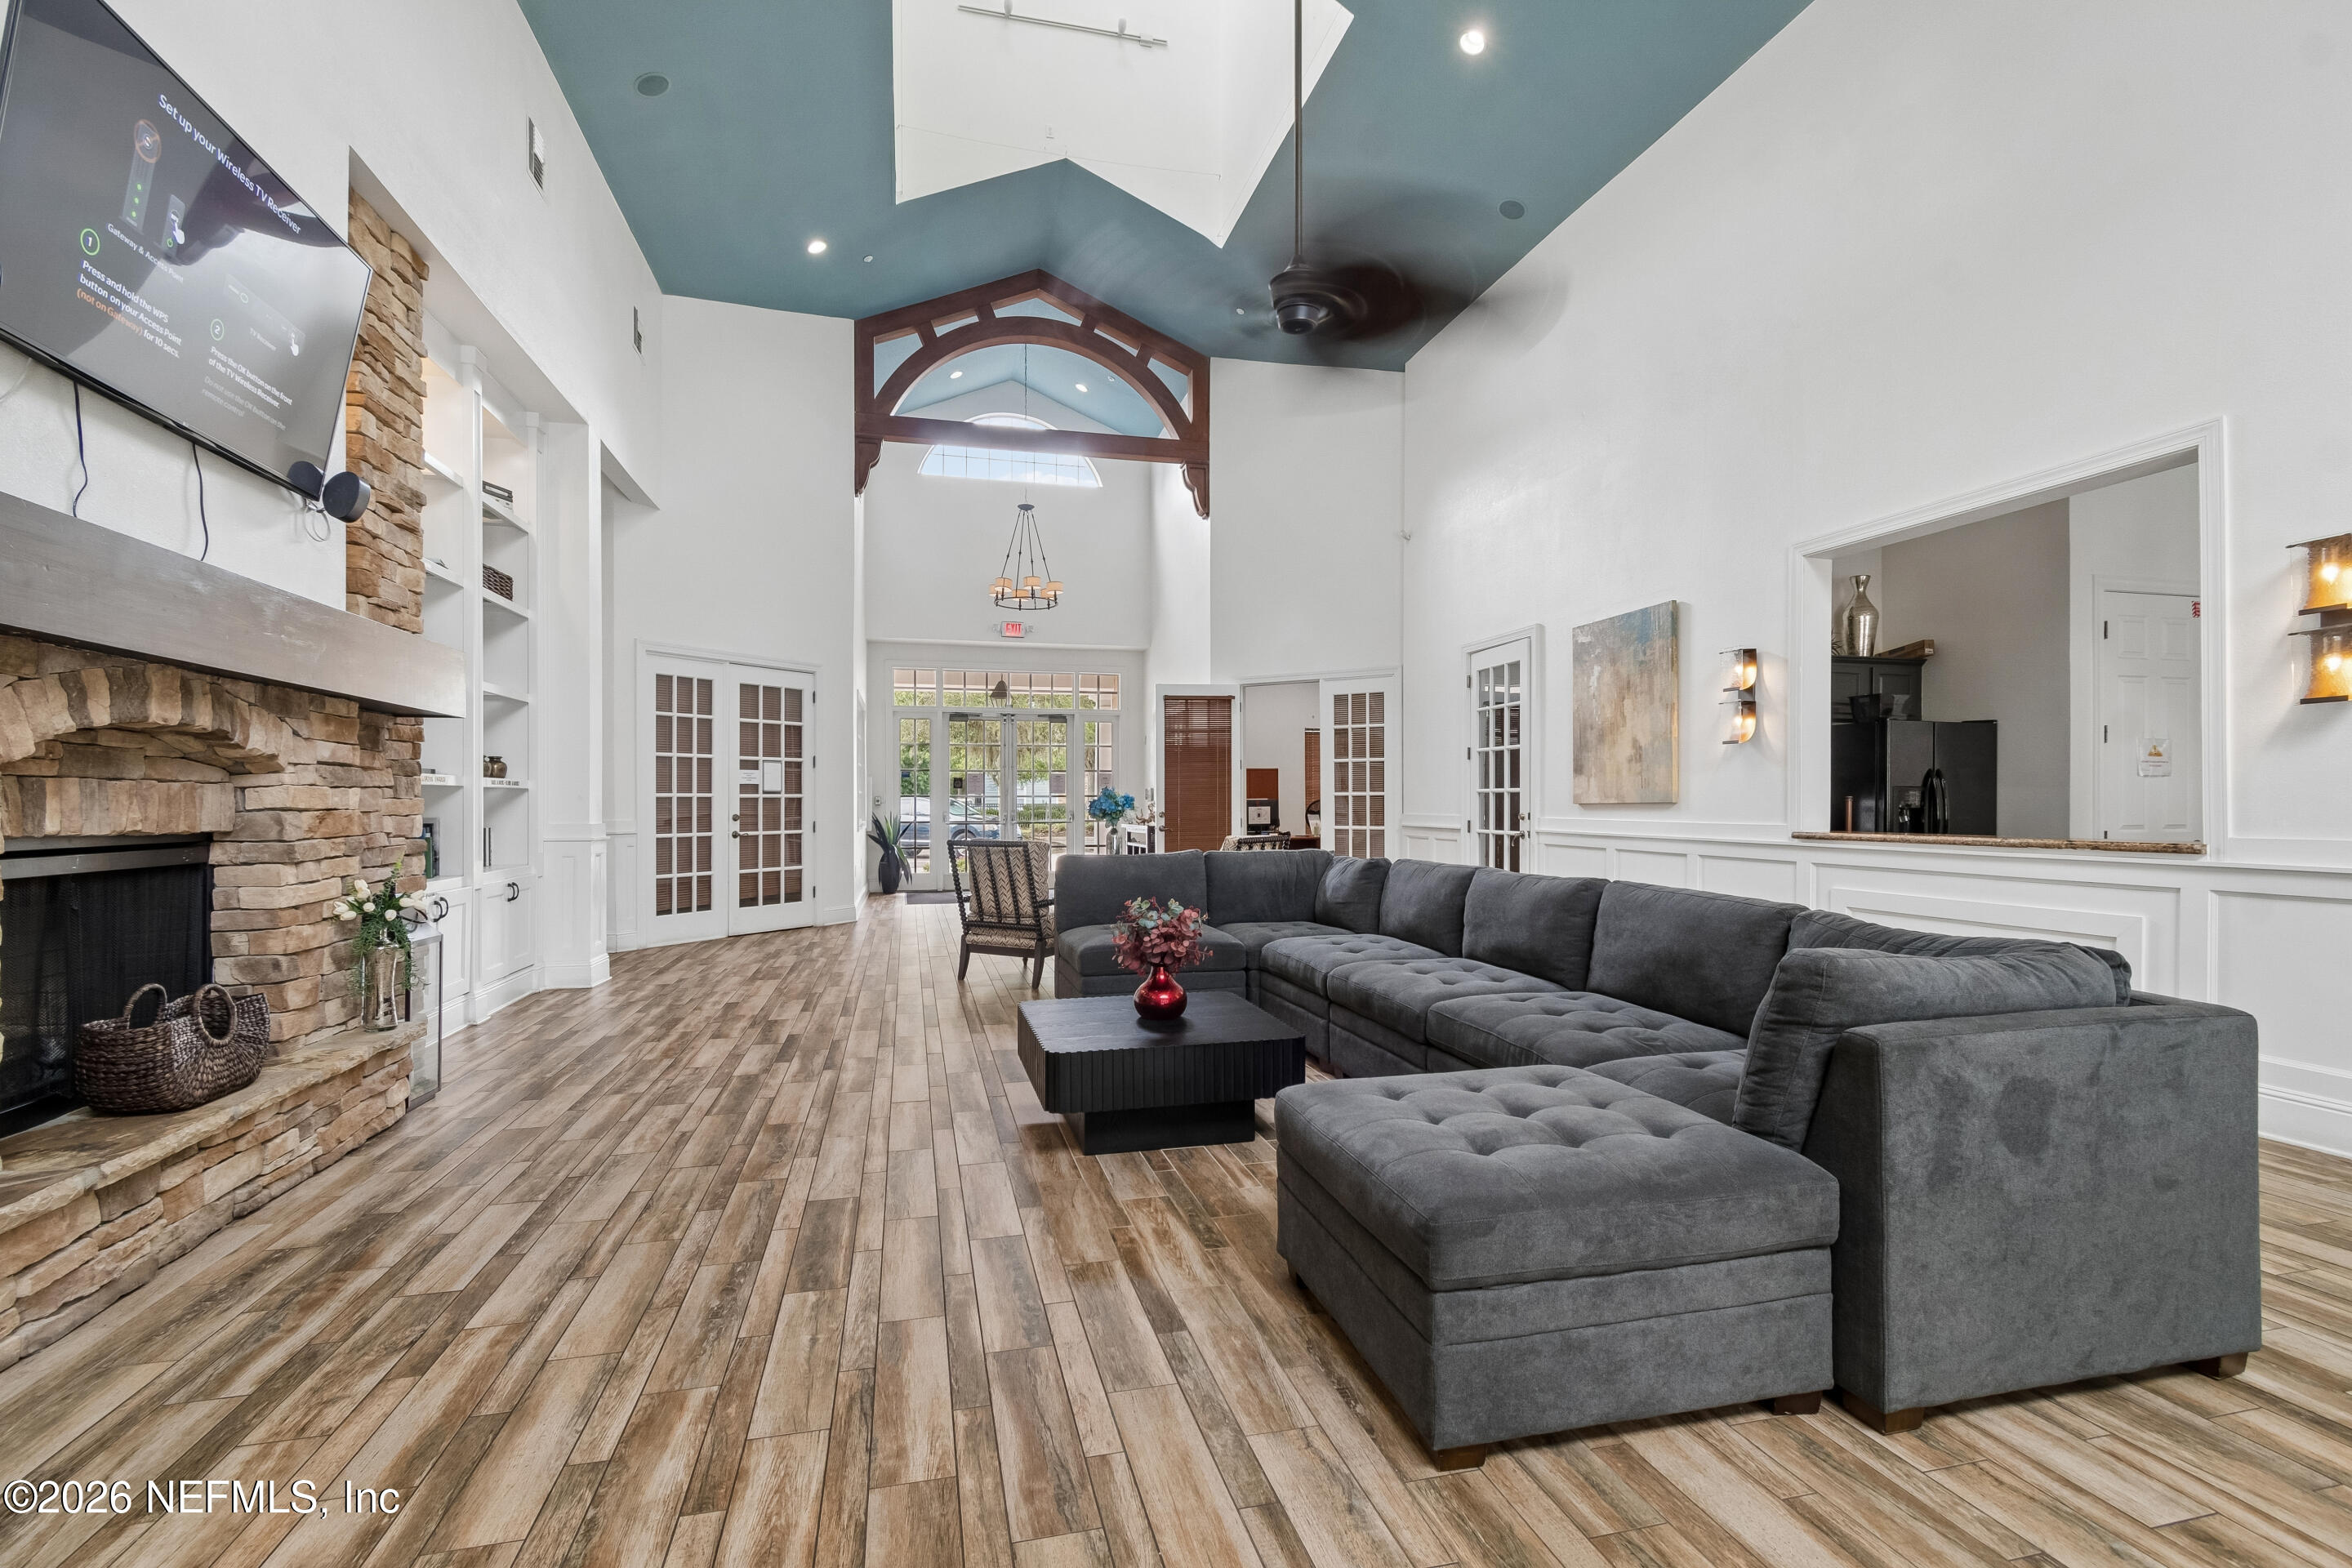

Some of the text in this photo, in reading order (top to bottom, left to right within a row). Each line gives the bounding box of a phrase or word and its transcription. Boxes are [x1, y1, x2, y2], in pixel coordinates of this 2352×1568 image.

[158, 94, 301, 234] Set up your Wireless TV Receiver
[107, 223, 137, 251] Gateway
[138, 246, 144, 255] &
[145, 251, 167, 272] Access
[80, 273, 182, 345] button on your Access Point
[82, 260, 169, 323] Press and hold the WPS
[77, 287, 180, 359] (not on Gateway) for 10 secs.
[204, 376, 214, 387] Do
[208, 359, 216, 367] of
[216, 361, 226, 373] the
[226, 368, 235, 379] TV
[235, 373, 257, 395] Wireless
[210, 345, 293, 406] Press the OK button on the front
[1006, 623, 1022, 635] EXIT
